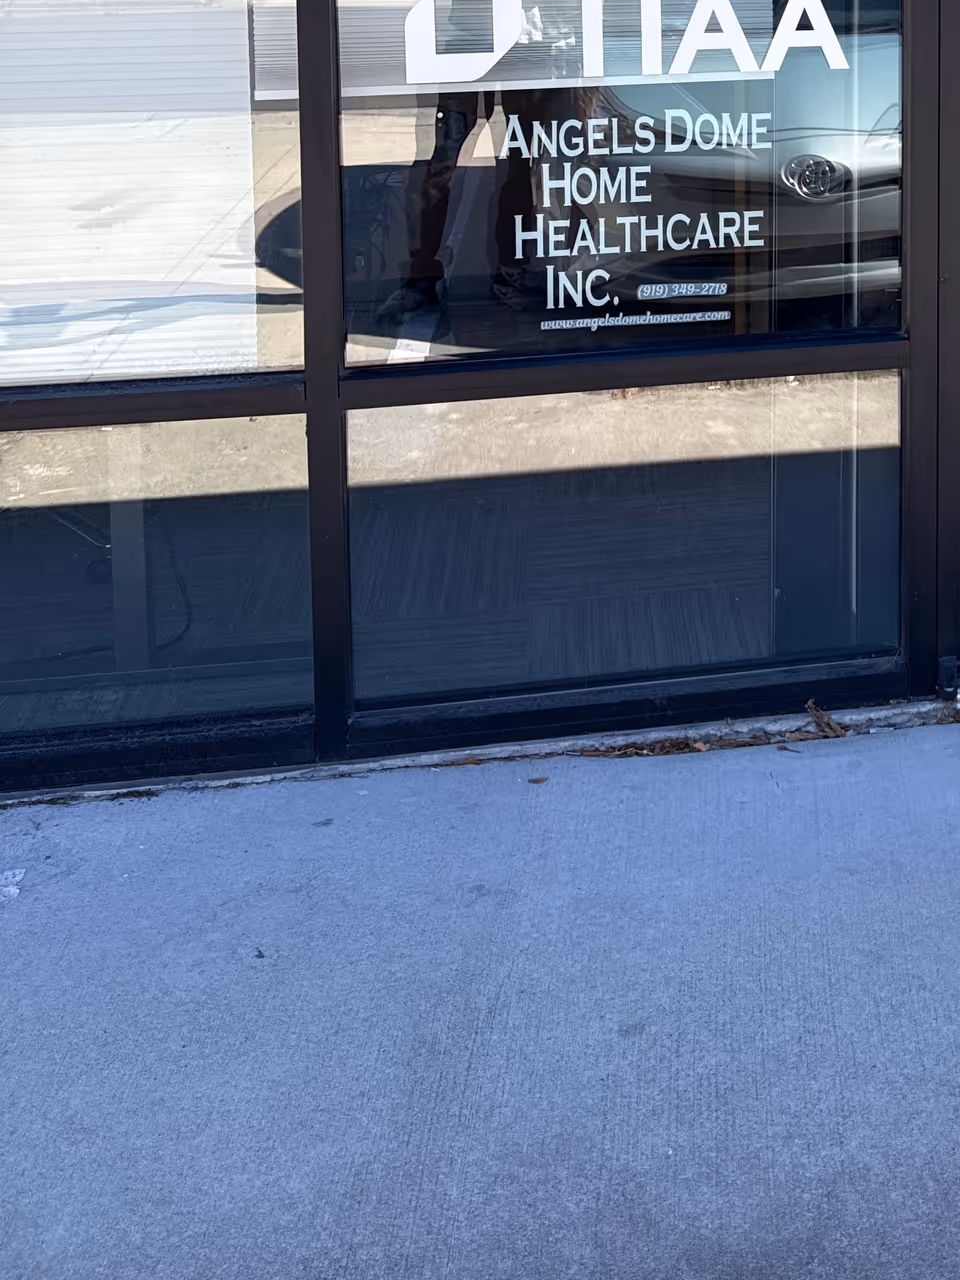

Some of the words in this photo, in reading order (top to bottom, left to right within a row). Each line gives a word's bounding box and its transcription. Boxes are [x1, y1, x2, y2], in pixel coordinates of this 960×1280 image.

[499, 114, 655, 159] ANGELS
[664, 109, 772, 154] DOME
[542, 161, 652, 208] HOME
[514, 210, 765, 260] HEALTHCARE
[545, 265, 620, 311] INC.
[637, 284, 668, 300] (919)
[671, 282, 728, 297] 349-2718
[540, 310, 731, 332] www.angelsdomehomecare.com
